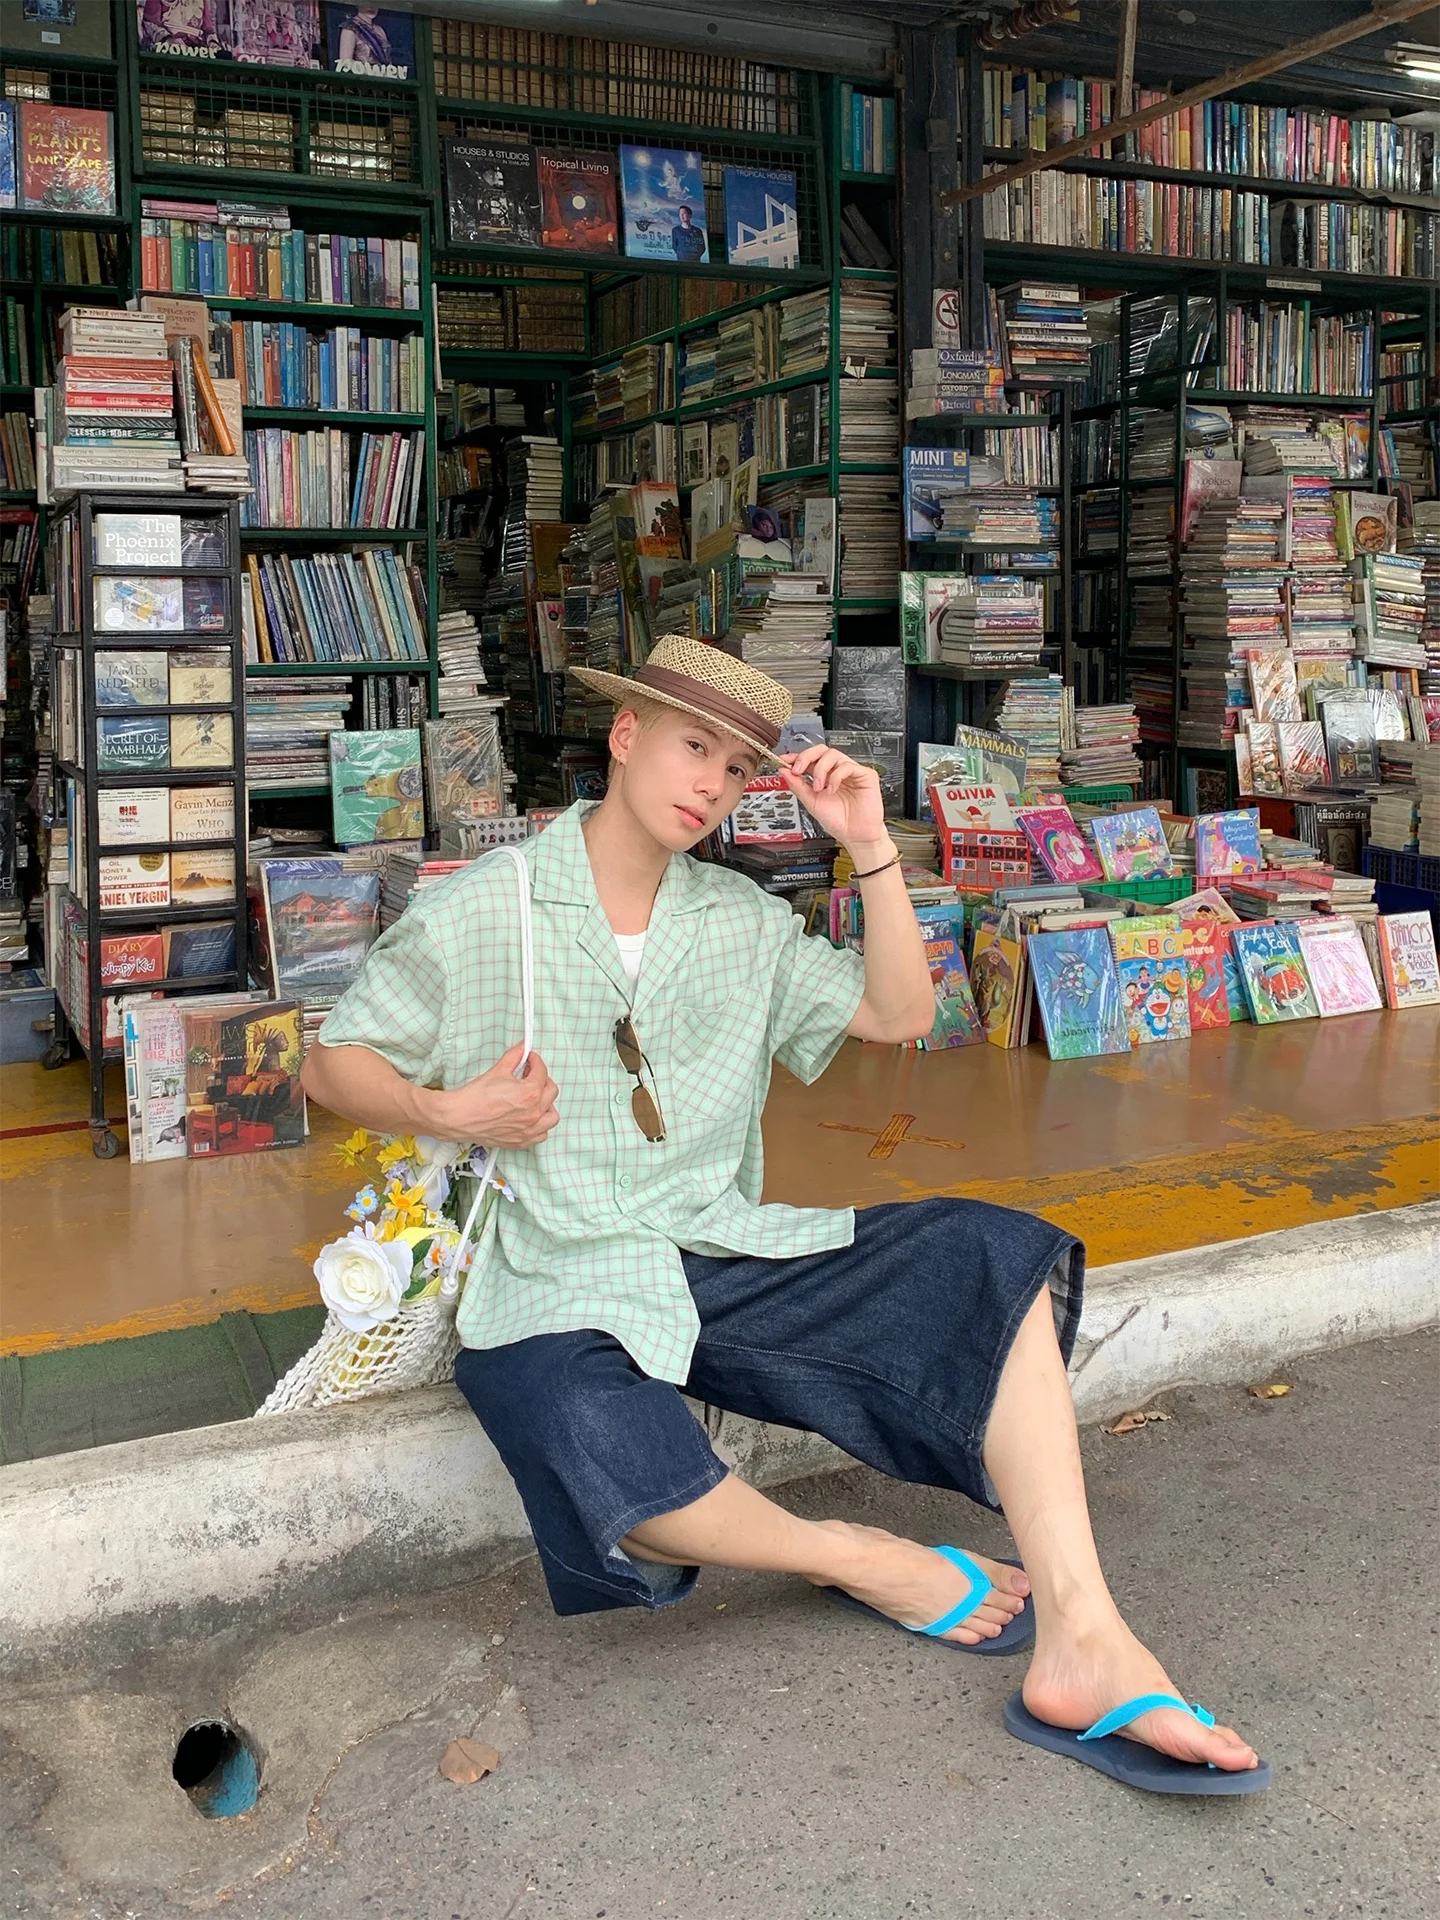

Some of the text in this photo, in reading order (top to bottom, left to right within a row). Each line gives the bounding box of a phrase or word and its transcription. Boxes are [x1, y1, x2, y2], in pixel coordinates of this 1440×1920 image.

[28, 132, 102, 152] PLANTS
[452, 145, 530, 161] HOUSES & STUDIOS
[541, 156, 579, 170] Tropical
[581, 160, 609, 174] Living
[736, 169, 766, 179] TROPICAL
[766, 173, 793, 182] HOUSES
[1320, 205, 1328, 241] DRAGONS
[939, 351, 975, 362] Oxford
[941, 371, 980, 380] LONGMAN
[910, 450, 945, 466] MINI
[130, 475, 160, 484] JOBS
[141, 518, 176, 534] The
[104, 533, 176, 549] Phoenix
[115, 548, 176, 566] Project
[108, 664, 148, 676] JAMES
[396, 707, 406, 728] SHI
[411, 706, 420, 728] SOL
[99, 732, 159, 745] SECRET OF
[969, 726, 1001, 740] Guide to
[873, 737, 882, 746] 3
[960, 733, 1026, 759] MAMMALS
[98, 744, 167, 756] HAMBHALA
[946, 786, 997, 801] OLIVIA
[174, 798, 234, 810] Gavin Menz
[197, 818, 224, 829] WHO
[1223, 824, 1248, 835] Magical
[1226, 833, 1256, 843] Creatures
[952, 845, 1027, 860] BIG BOOK
[99, 890, 168, 907] ANIEL YERGIN
[108, 941, 144, 954] DIARY
[1184, 945, 1215, 957] ntures
[119, 953, 128, 962] of
[101, 957, 155, 977] Wimpy Kid
